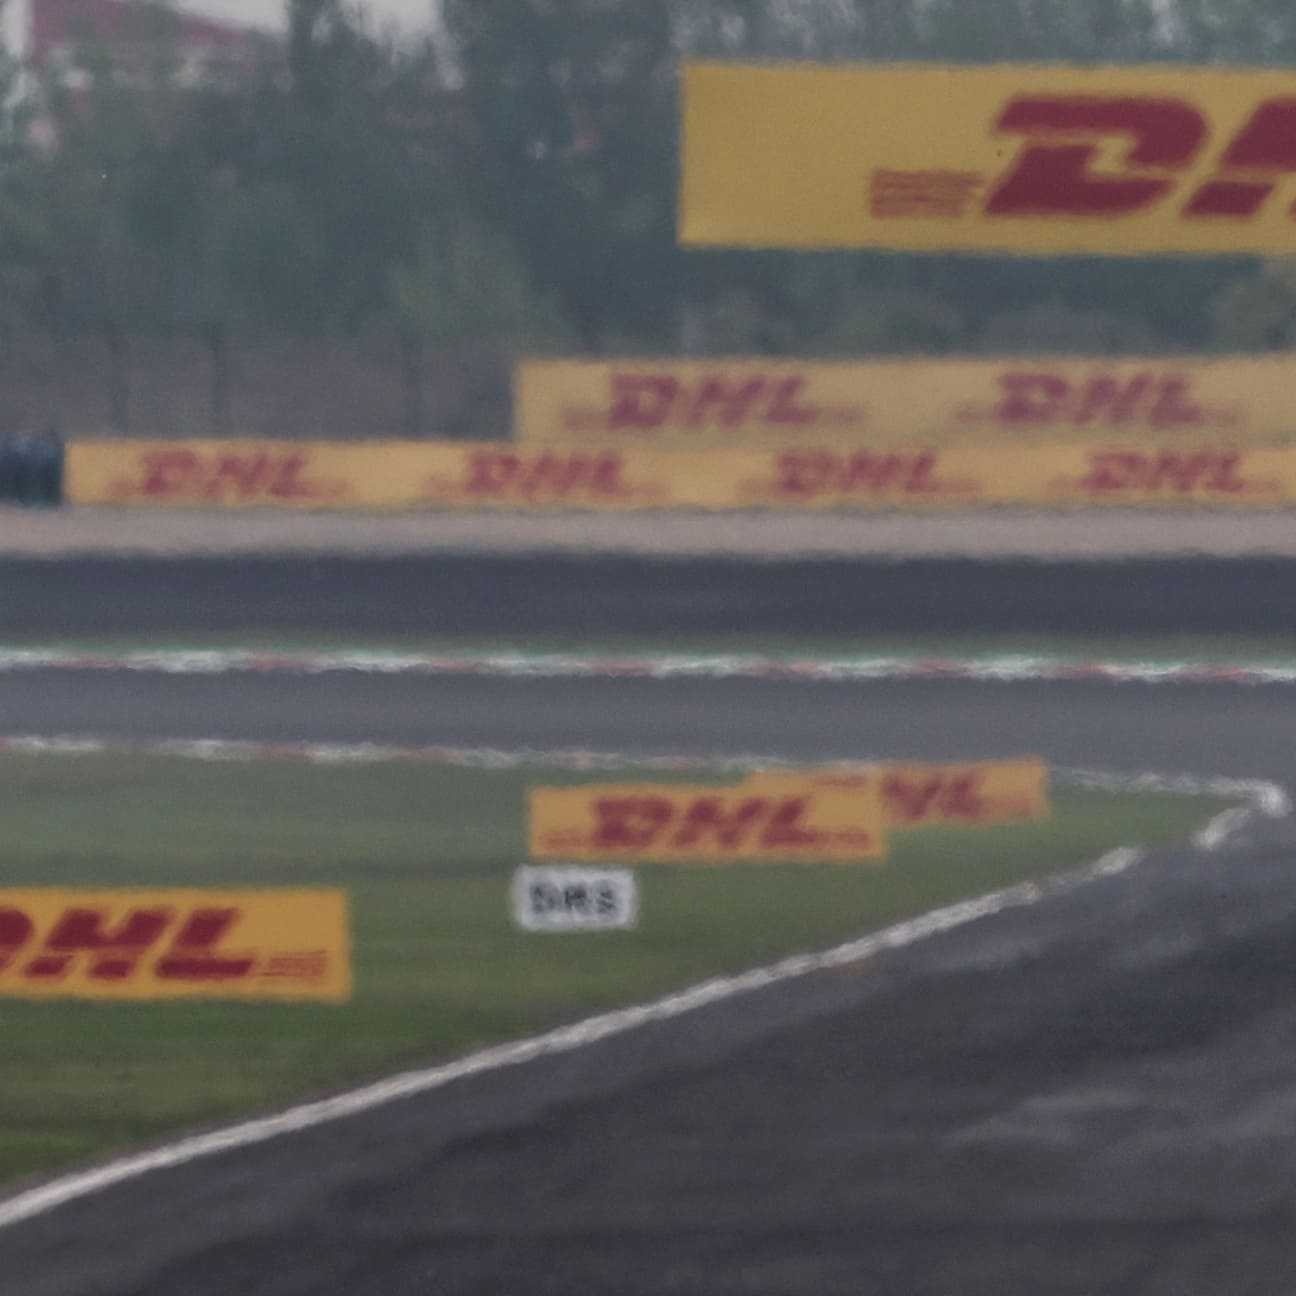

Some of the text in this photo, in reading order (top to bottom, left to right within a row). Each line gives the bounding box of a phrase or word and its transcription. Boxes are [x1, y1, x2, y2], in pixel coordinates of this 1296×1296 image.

[610, 374, 818, 430] DHL
[998, 366, 1206, 426] DHL
[141, 449, 310, 498] DHL
[467, 451, 626, 497] DHL
[773, 450, 938, 495] DHL
[1085, 450, 1247, 496] DHL
[594, 796, 815, 850] DHL
[0, 907, 255, 980] HL
